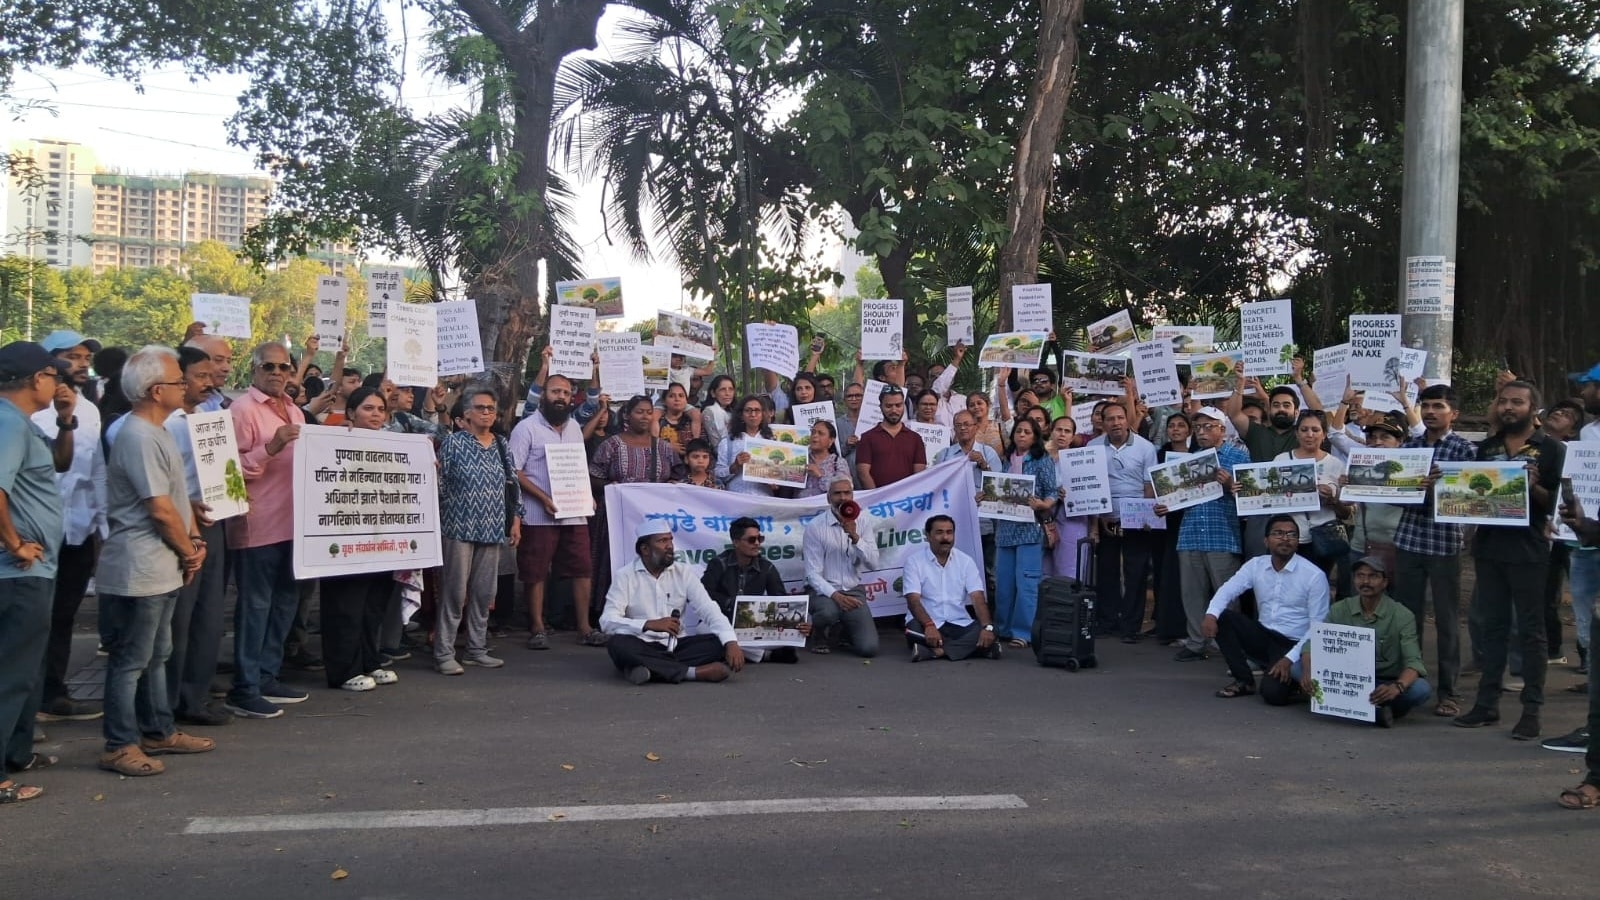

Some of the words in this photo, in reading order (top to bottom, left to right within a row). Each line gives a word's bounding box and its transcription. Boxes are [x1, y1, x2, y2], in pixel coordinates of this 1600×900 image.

[396, 303, 413, 313] Trees
[1242, 307, 1276, 316] CONCRETE
[1352, 320, 1395, 328] PROGRESS
[1352, 330, 1398, 338] SHOULDN'T
[1352, 340, 1385, 349] REQUIRE
[1324, 349, 1348, 358] PLANNED
[1352, 350, 1364, 358] AN
[1366, 350, 1382, 358] AXE
[1314, 357, 1345, 368] BOTTLENECK
[196, 422, 210, 434] आज
[211, 417, 226, 433] नाही
[198, 438, 206, 450] तर
[208, 433, 227, 447] कधीच
[201, 450, 215, 465] नाही
[335, 449, 363, 465] पुण्याचा
[365, 451, 393, 463] वाढलाय
[394, 452, 410, 465] पारा,
[315, 467, 337, 483] एप्रिल
[339, 468, 347, 482] मे
[348, 468, 381, 484] महिन्यात
[384, 472, 406, 484] पडताय
[407, 473, 421, 484] गारा
[325, 489, 359, 504] अधिकारी
[361, 490, 378, 505] झाले
[380, 490, 400, 504] पैशाने
[402, 493, 420, 506] लाल,
[869, 492, 934, 518] वाचवा
[943, 489, 949, 509] !
[318, 511, 360, 526] नागरिकांचे
[362, 513, 378, 526] मात्र
[379, 511, 405, 525] होतायत
[406, 513, 420, 524] हाल
[398, 541, 408, 555] पुणे
[675, 547, 713, 564] ave
